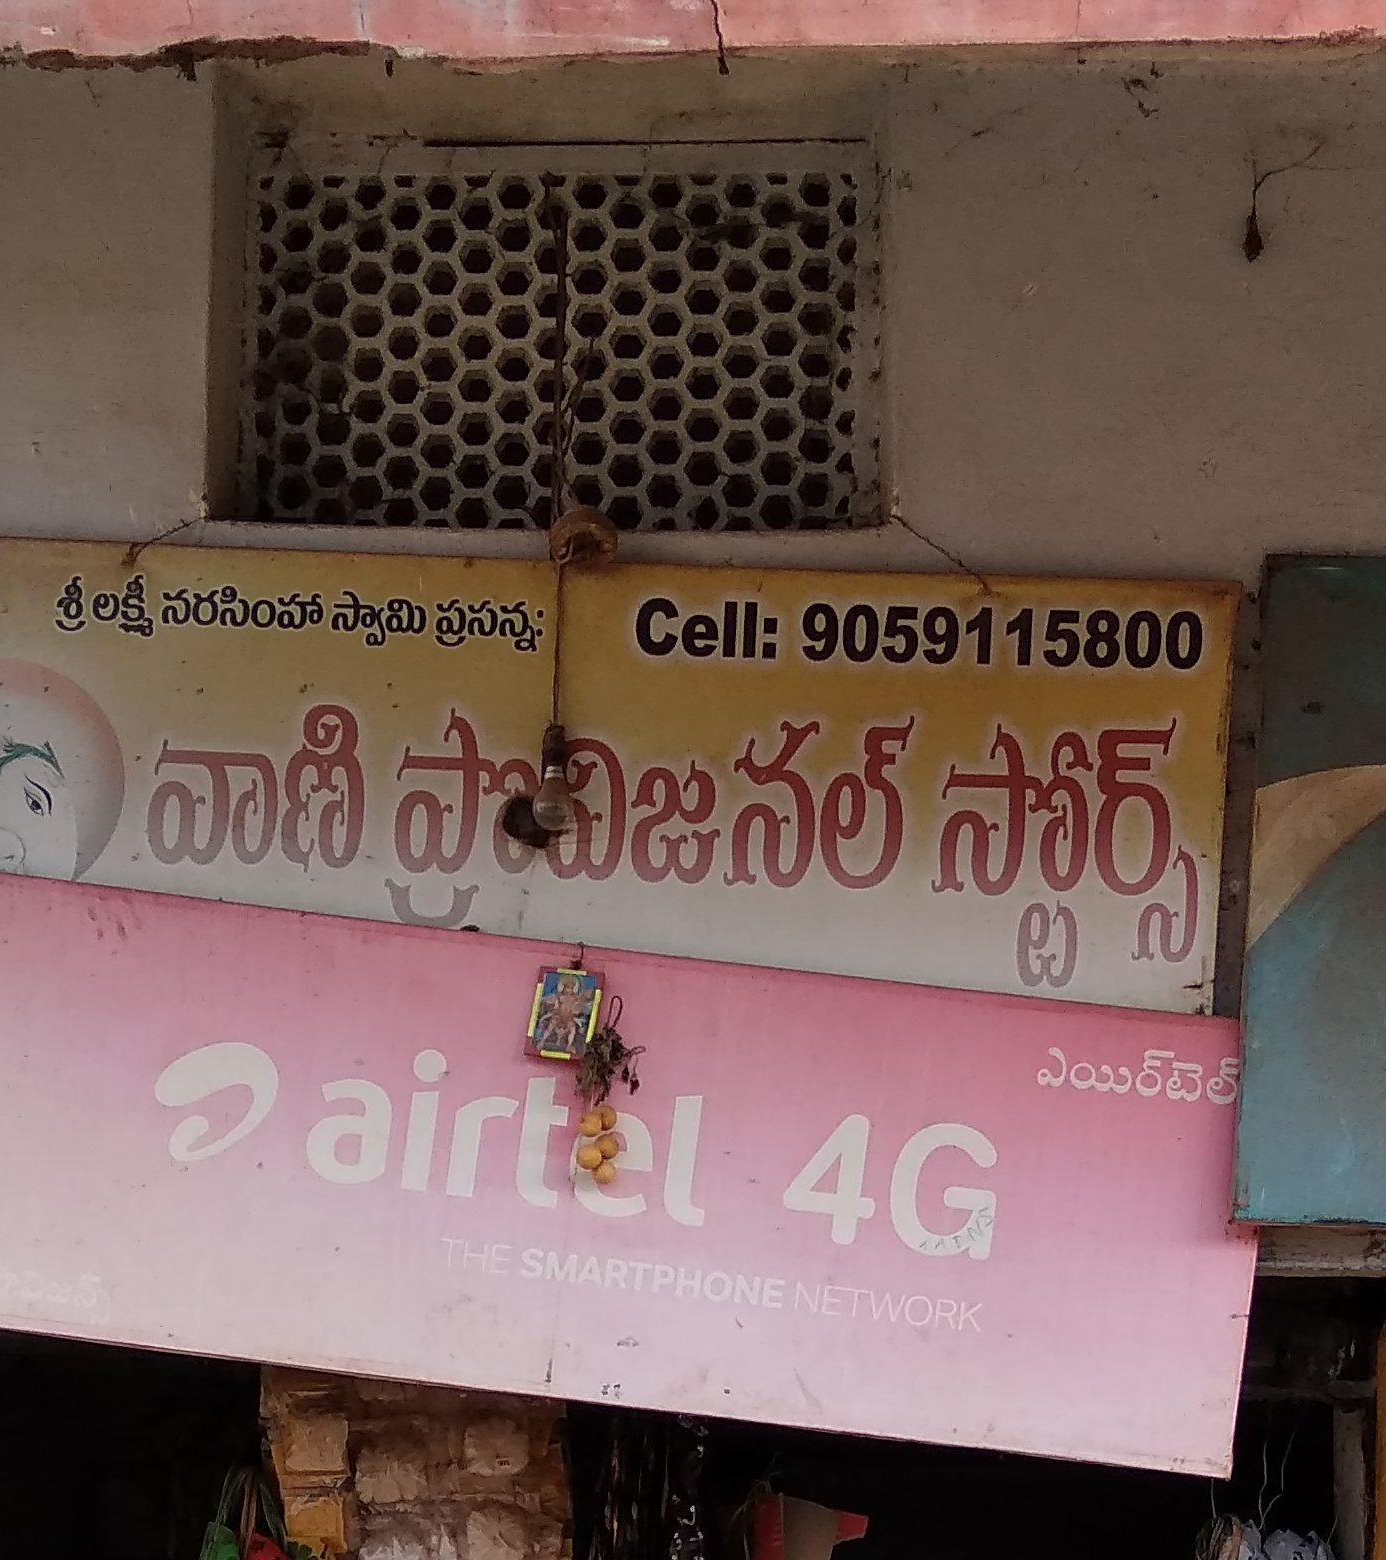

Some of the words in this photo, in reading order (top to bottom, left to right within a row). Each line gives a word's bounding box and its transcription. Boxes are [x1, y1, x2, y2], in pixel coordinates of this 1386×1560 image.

[55, 576, 86, 631] శ్రీ
[332, 591, 427, 648] స్వామి
[635, 598, 779, 660] Cell:
[802, 603, 1204, 670] 9059115800
[306, 1048, 706, 1228] airtel
[782, 1113, 1001, 1263] 4G
[441, 1237, 513, 1274] THE
[520, 1246, 785, 1309] SMARTPHONE
[794, 1281, 985, 1333] NETWORK
